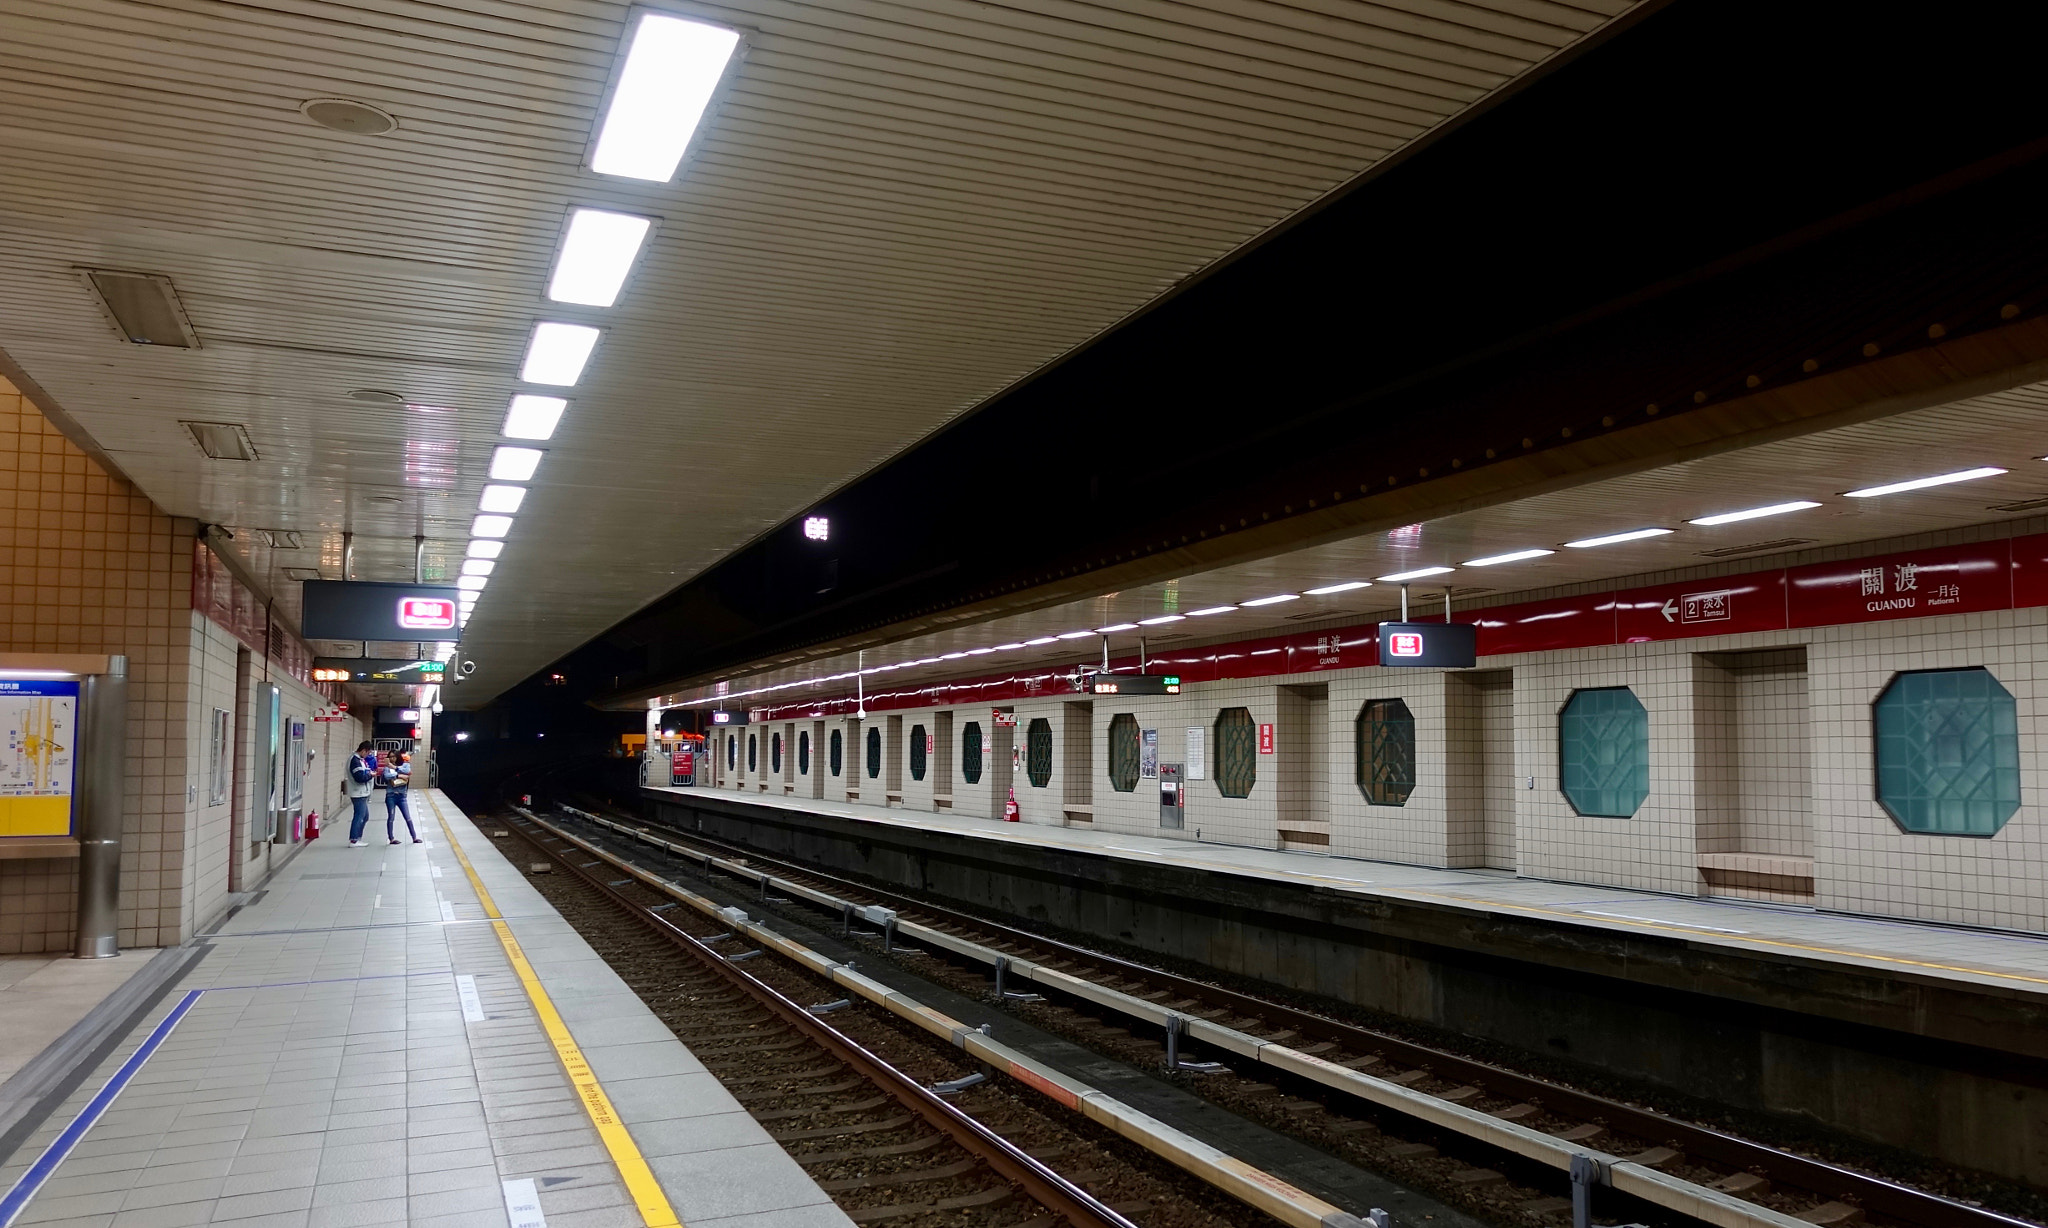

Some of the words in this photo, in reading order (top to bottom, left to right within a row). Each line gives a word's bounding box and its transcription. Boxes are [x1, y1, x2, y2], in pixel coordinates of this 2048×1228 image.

[1861, 563, 1918, 596] 關渡
[1928, 584, 1960, 598] 一月台
[1688, 602, 1696, 615] 2
[1703, 596, 1725, 609] 淡水
[1867, 598, 1915, 612] GUANDU
[1703, 608, 1725, 618] Tamsui
[422, 663, 444, 671] 21:00
